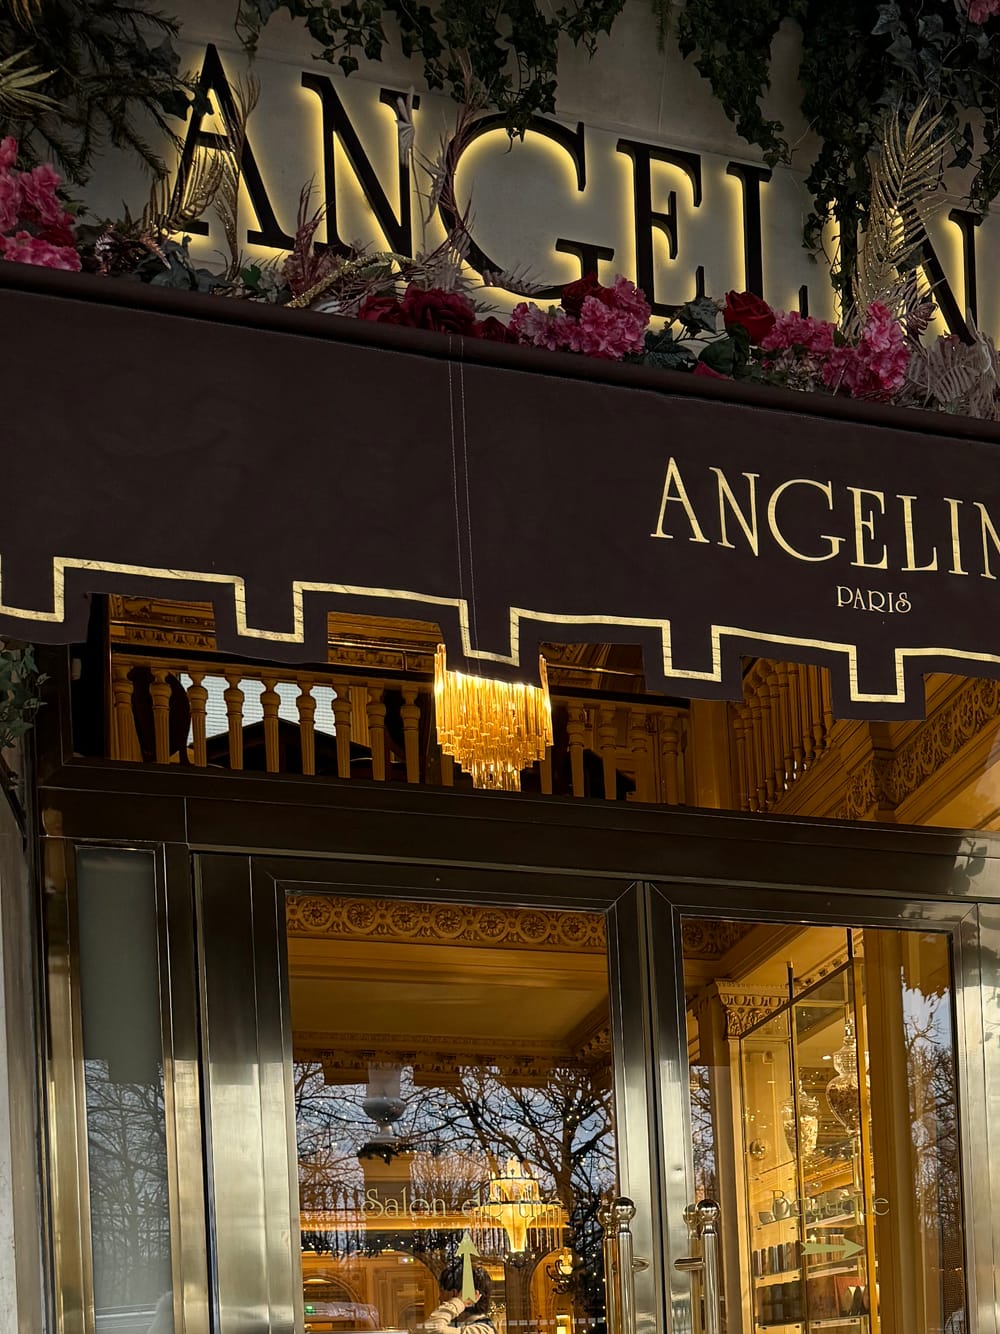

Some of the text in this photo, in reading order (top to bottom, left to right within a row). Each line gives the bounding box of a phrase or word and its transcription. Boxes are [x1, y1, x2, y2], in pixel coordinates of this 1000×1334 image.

[836, 585, 912, 614] PARIS
[361, 1186, 446, 1218] Salon
[461, 1187, 504, 1218] de
